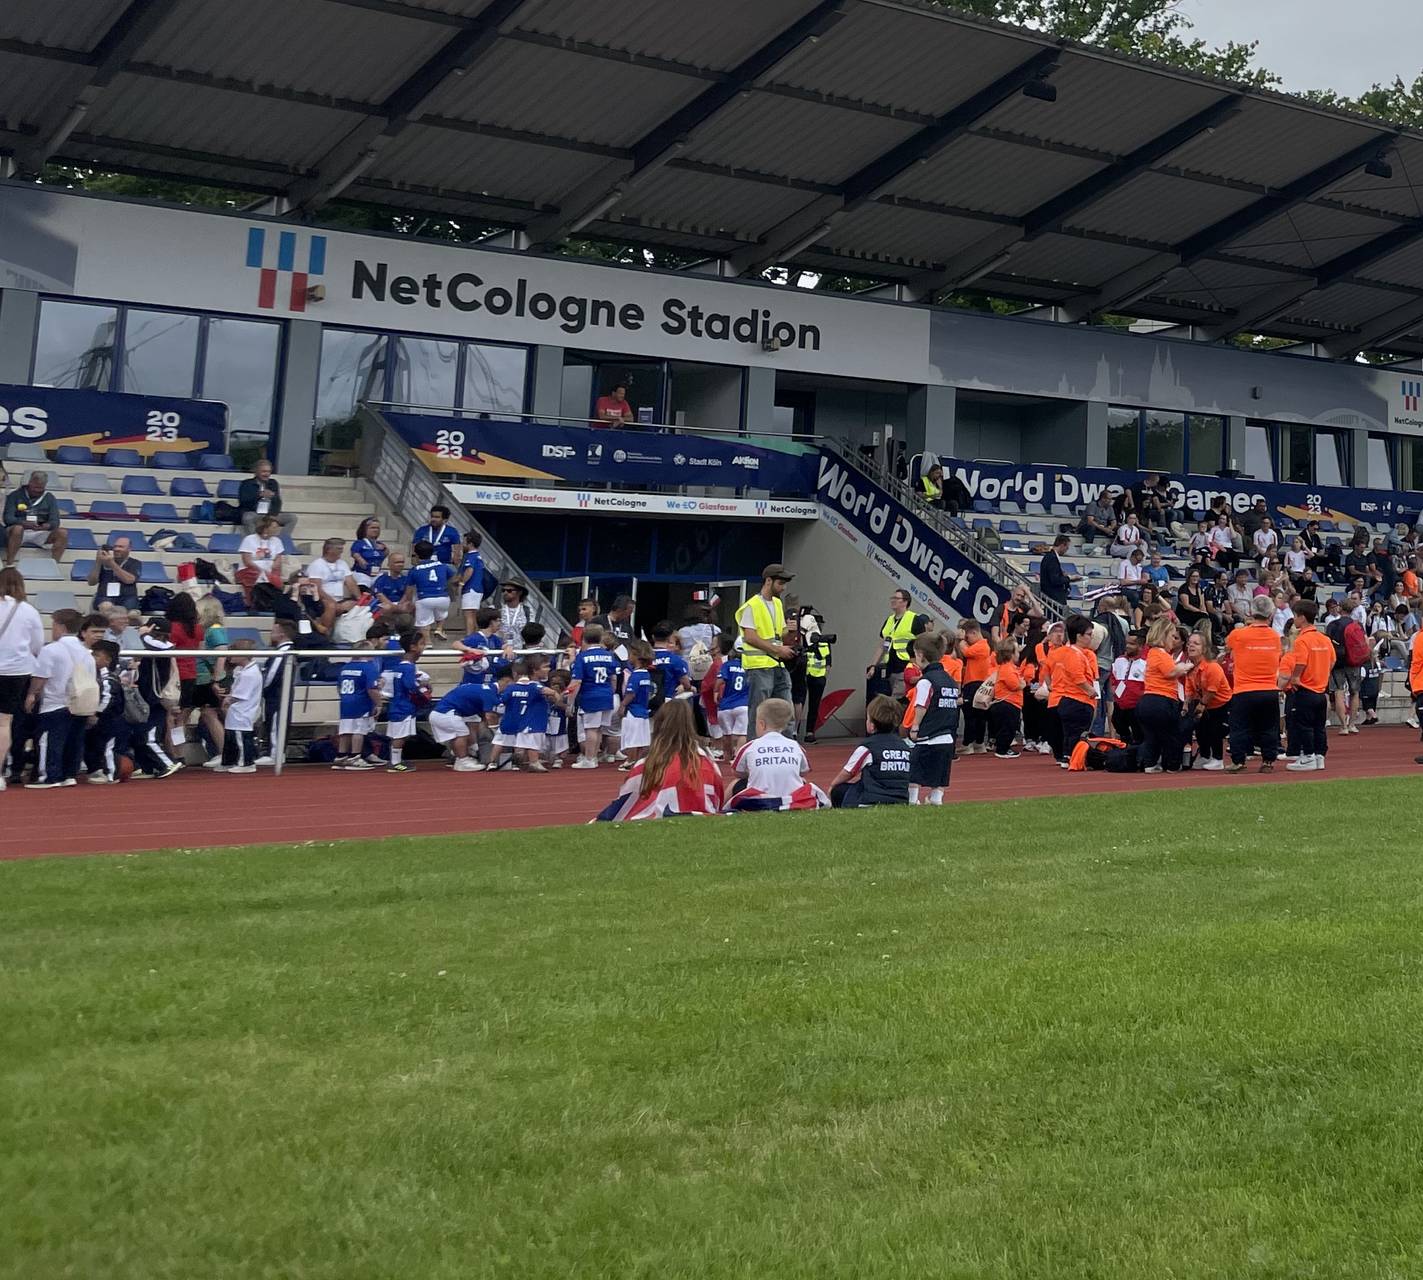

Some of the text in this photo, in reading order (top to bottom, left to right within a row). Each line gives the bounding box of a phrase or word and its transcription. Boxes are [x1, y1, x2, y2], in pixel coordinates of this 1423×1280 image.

[351, 259, 821, 351] NetCologne Stadion
[147, 410, 181, 427] 20
[145, 426, 178, 442] 23
[436, 430, 465, 445] 20
[436, 444, 463, 460] 23
[475, 491, 557, 503] We Glasfaser
[594, 497, 647, 508] NetCologne
[1306, 494, 1322, 504] 20
[666, 501, 737, 512] We Glasfaser
[770, 505, 817, 516] NetCologne
[1308, 504, 1322, 515] 23
[817, 456, 890, 534] World
[889, 514, 974, 600] Dwarf
[429, 569, 438, 582] 4
[584, 655, 612, 663] FRANCE
[593, 667, 608, 684] 78
[734, 676, 743, 691] 8
[520, 700, 528, 715] 7
[757, 746, 794, 755] GREAT
[882, 749, 910, 761] GREAT
[755, 756, 799, 767] BRITAIN
